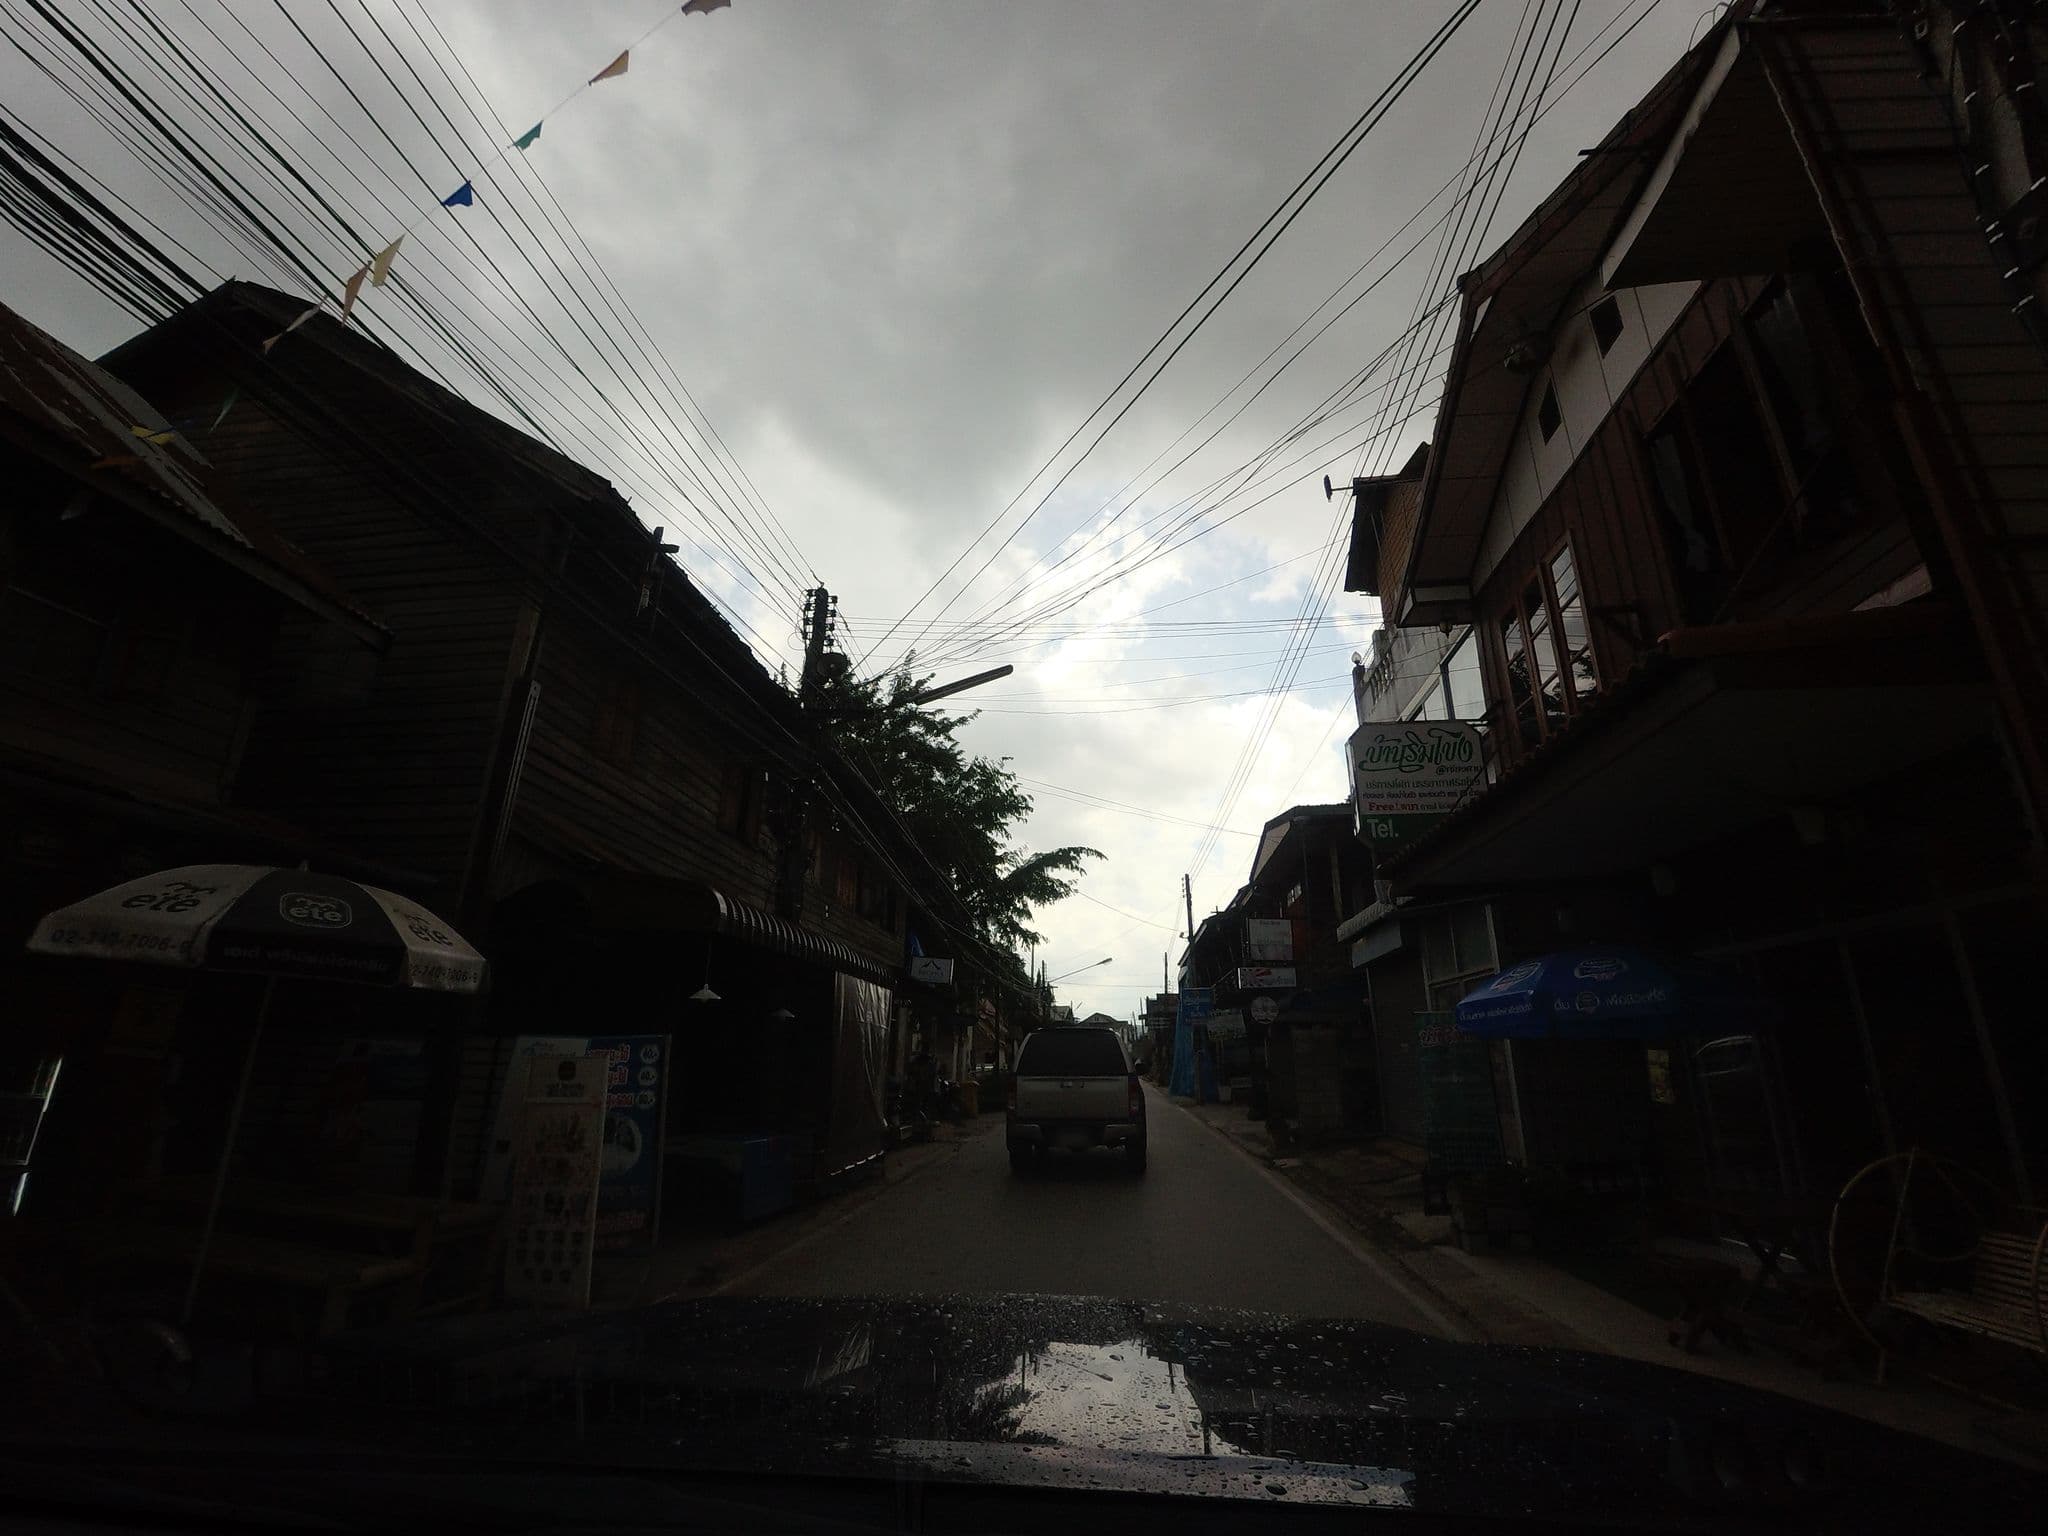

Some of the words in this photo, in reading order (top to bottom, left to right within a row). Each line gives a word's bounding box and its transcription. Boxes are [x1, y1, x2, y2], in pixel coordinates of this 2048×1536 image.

[1359, 728, 1473, 772] บ้านริมโขง
[1366, 818, 1399, 839] Tel.
[121, 889, 200, 914] ete
[288, 902, 345, 923] ete
[408, 922, 454, 947] ete
